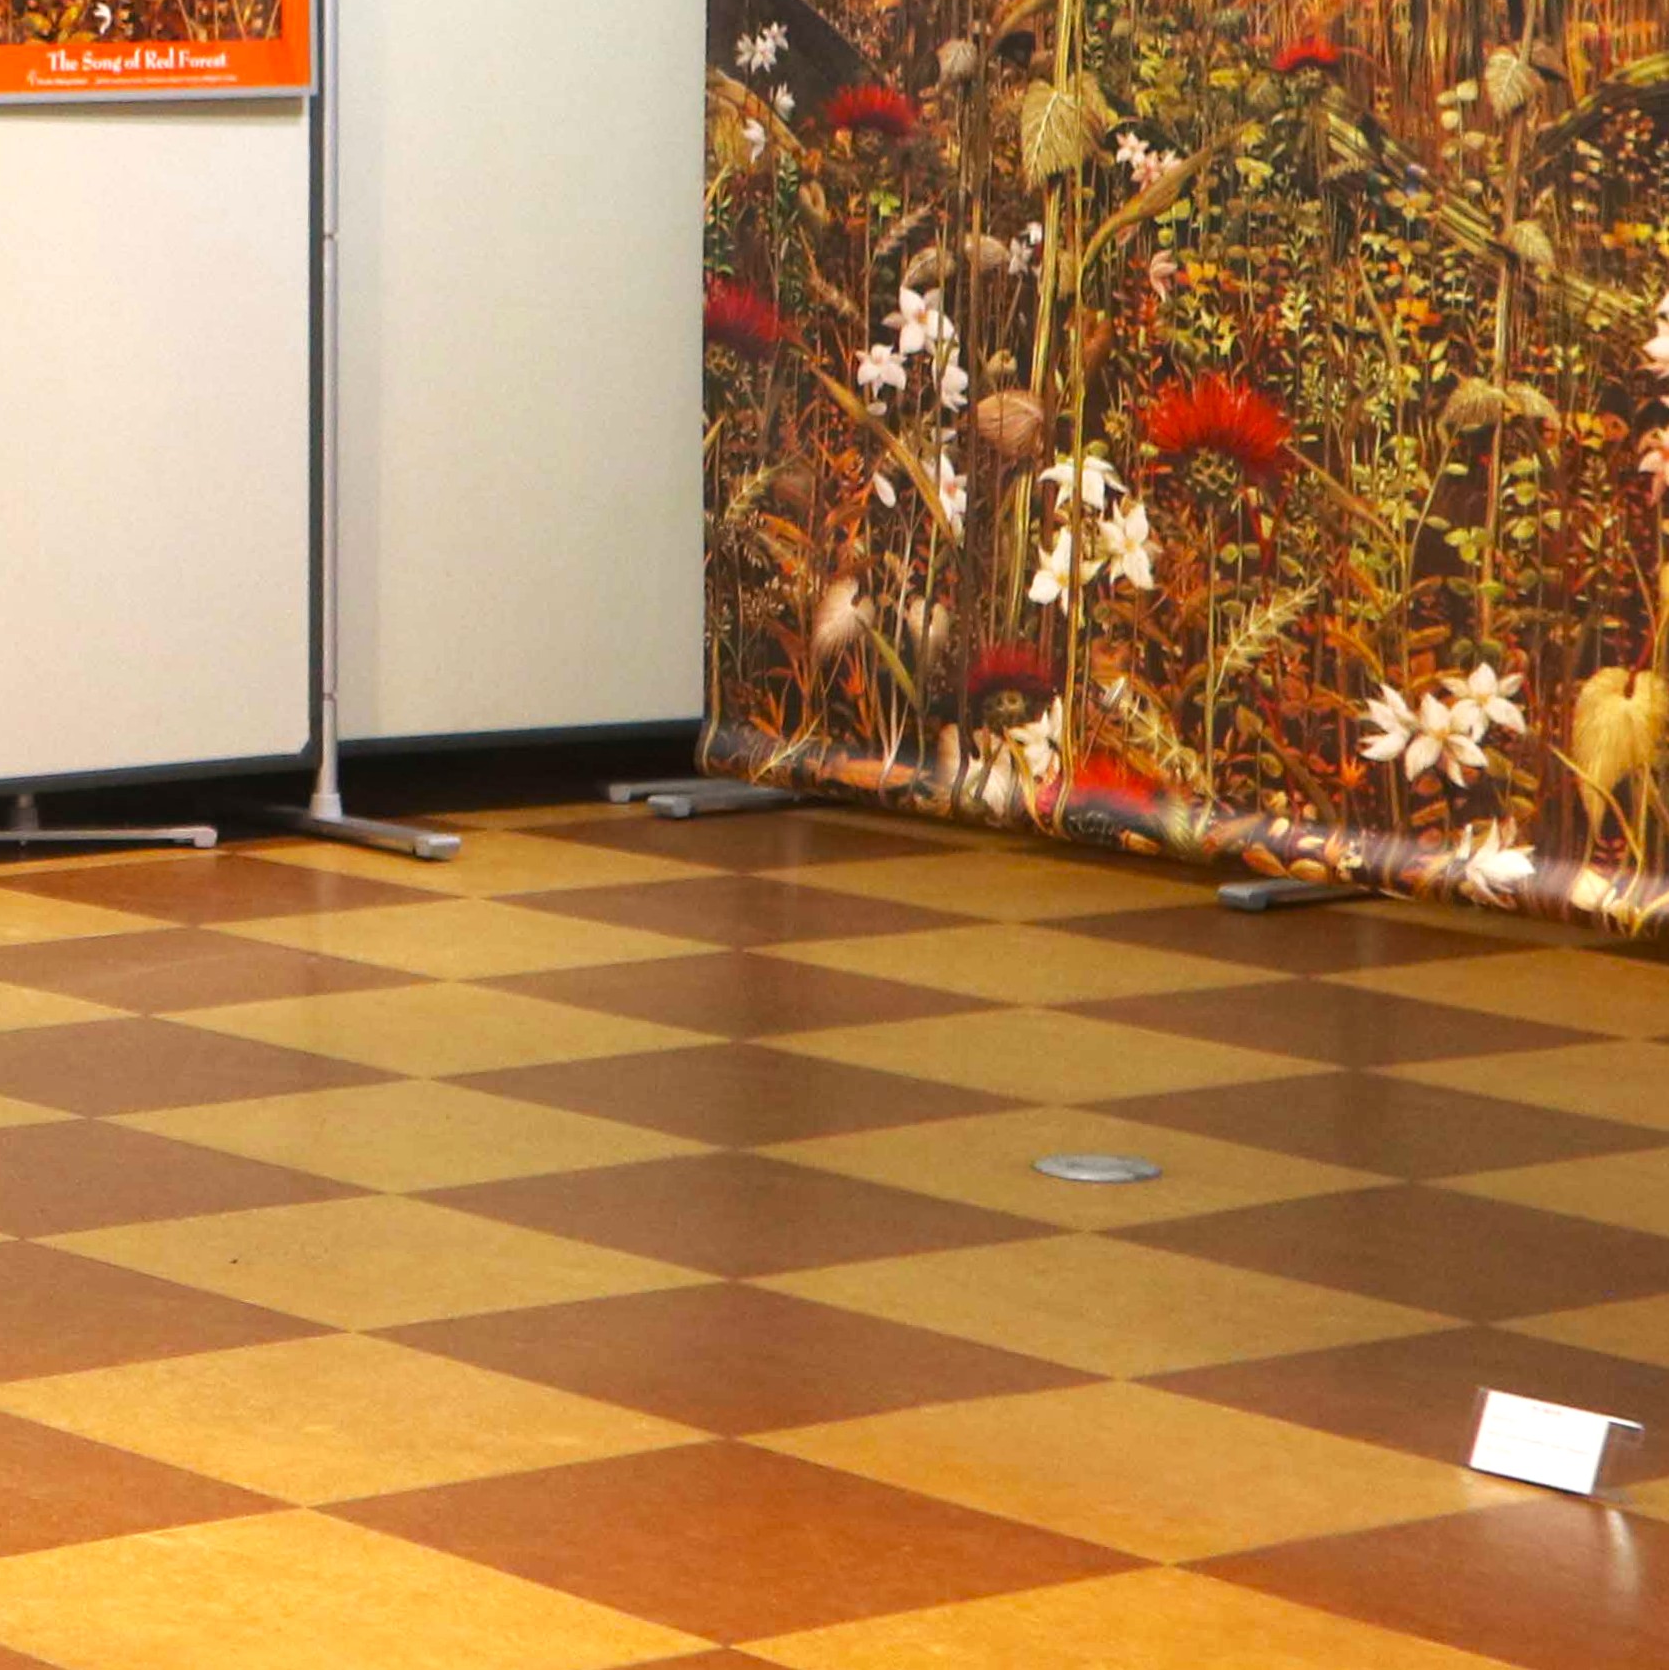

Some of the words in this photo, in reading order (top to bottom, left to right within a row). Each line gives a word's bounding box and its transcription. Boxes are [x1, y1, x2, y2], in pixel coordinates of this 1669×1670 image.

[46, 48, 79, 72] The
[81, 50, 123, 75] Song
[123, 47, 141, 70] of
[144, 46, 175, 70] Red
[178, 48, 227, 69] Forest
